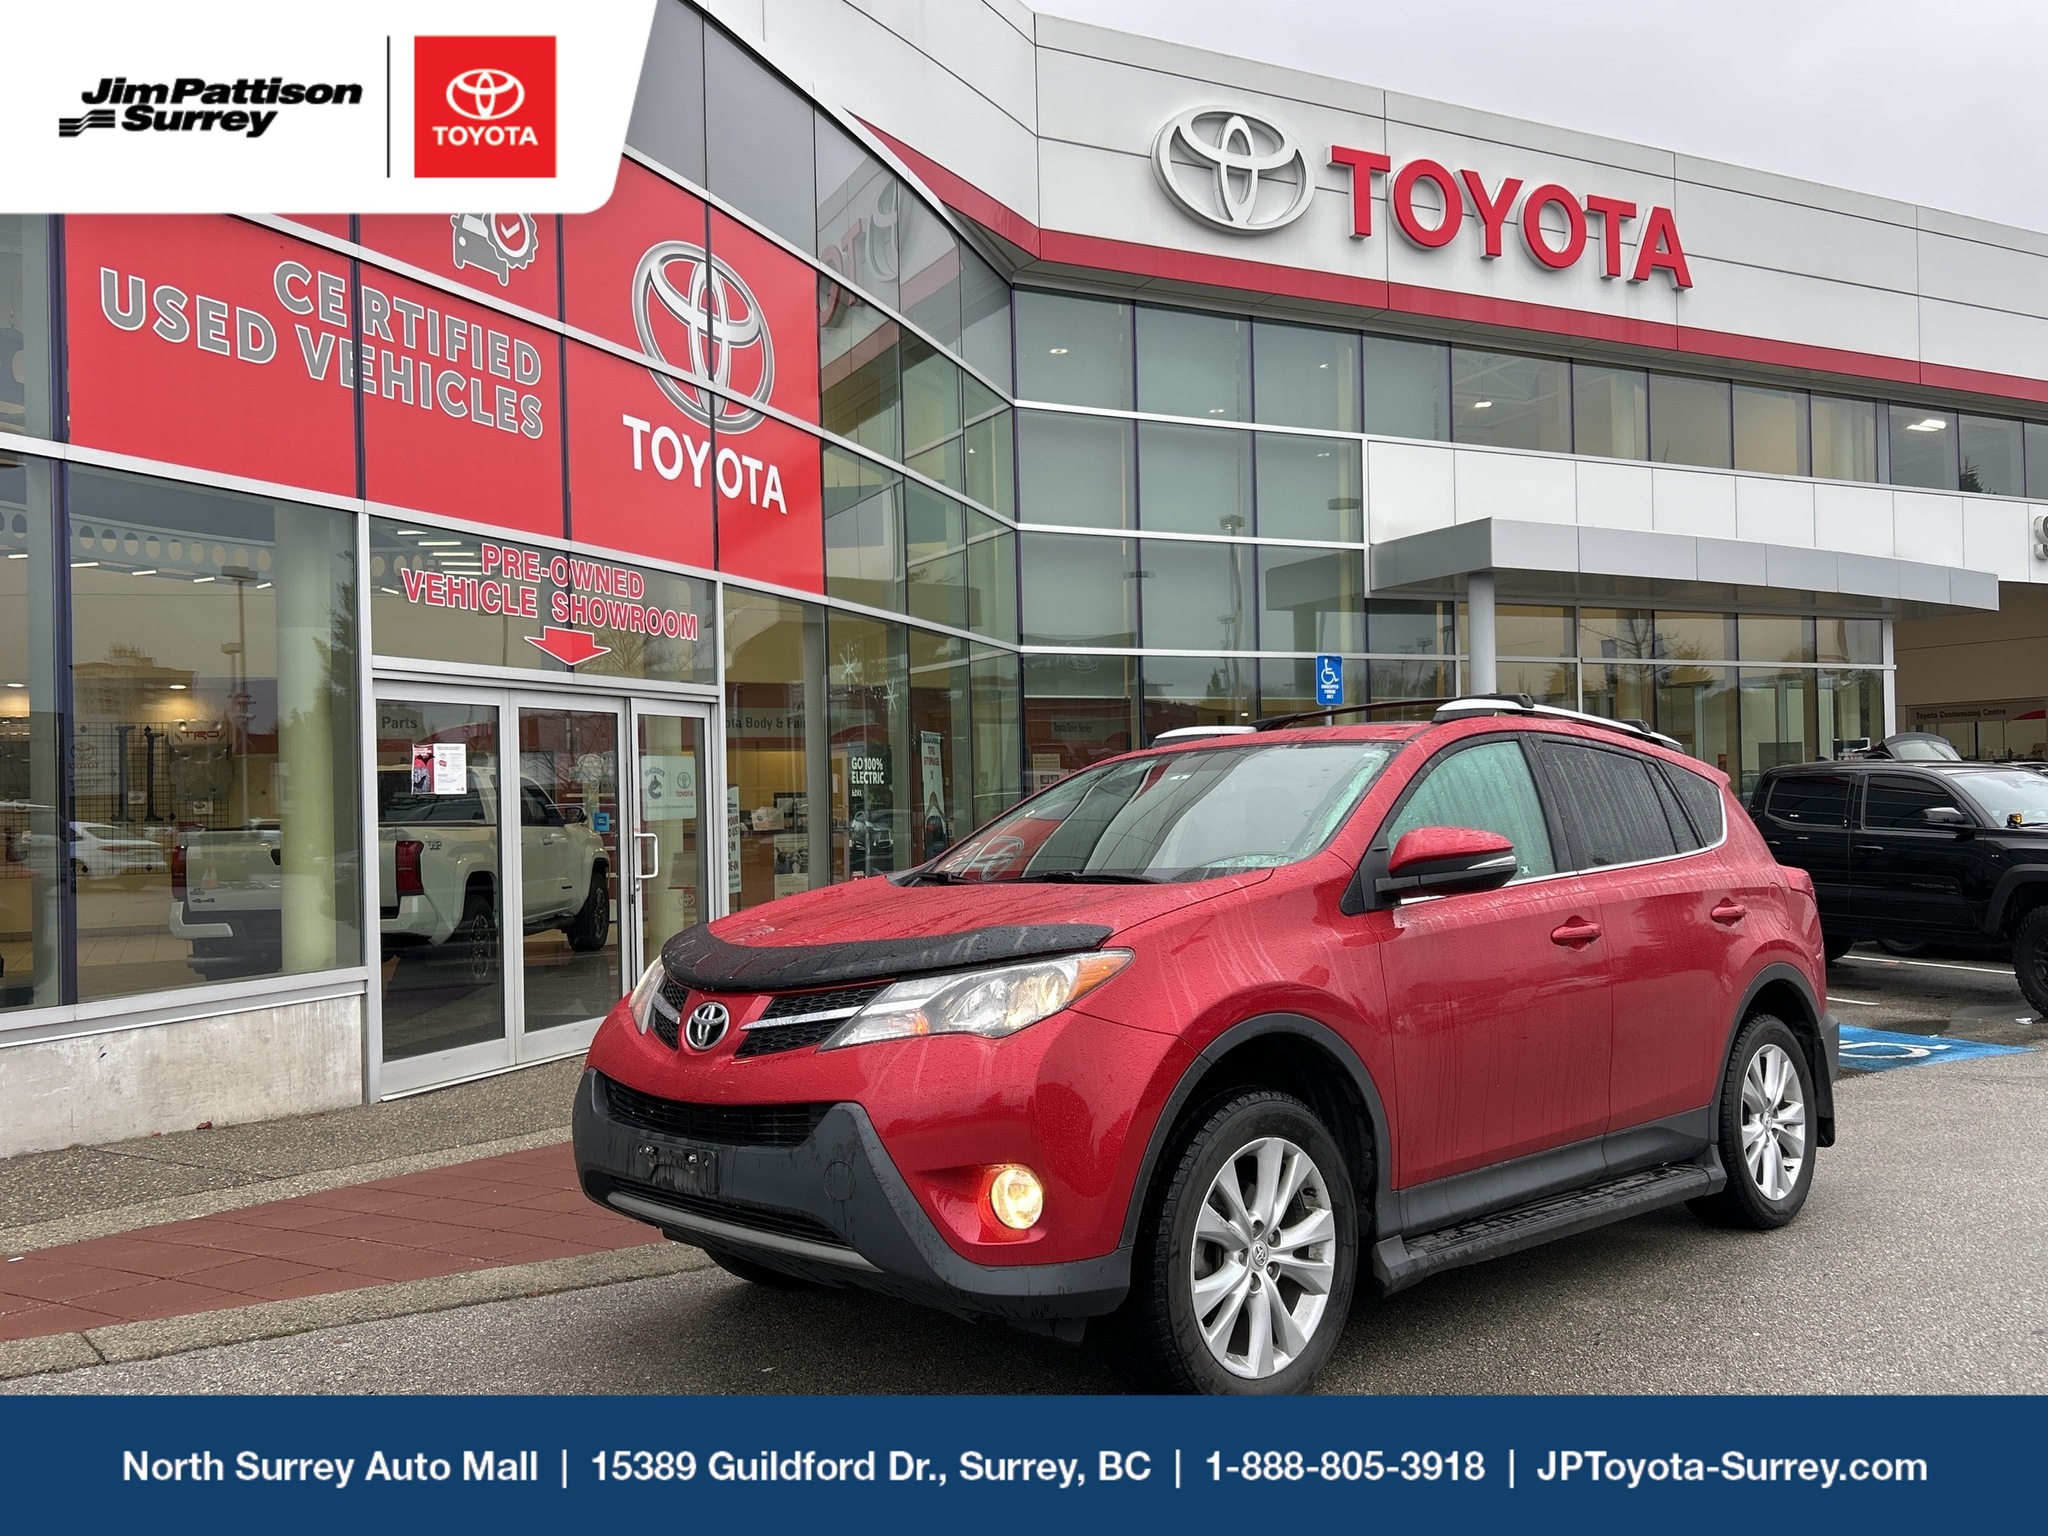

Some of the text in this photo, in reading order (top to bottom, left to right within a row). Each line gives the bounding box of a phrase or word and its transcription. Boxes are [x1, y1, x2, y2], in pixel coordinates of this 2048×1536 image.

[1326, 144, 1693, 291] TOYOTA
[273, 260, 543, 386] CERTIFIED
[100, 266, 544, 440] USED VEHICLES
[622, 413, 788, 515] TOYOTA
[481, 543, 645, 600] PRE-OWNED
[401, 568, 698, 641] VEHICLE SHOWROOM
[381, 716, 418, 729] Parts
[726, 719, 742, 728] ota
[745, 717, 773, 731] Body
[776, 718, 784, 729] &
[1915, 708, 2007, 721] Toyota Customizing Centre
[181, 730, 220, 741] TRD
[851, 757, 883, 771] GO 100%
[852, 771, 884, 785] ELECTRIC
